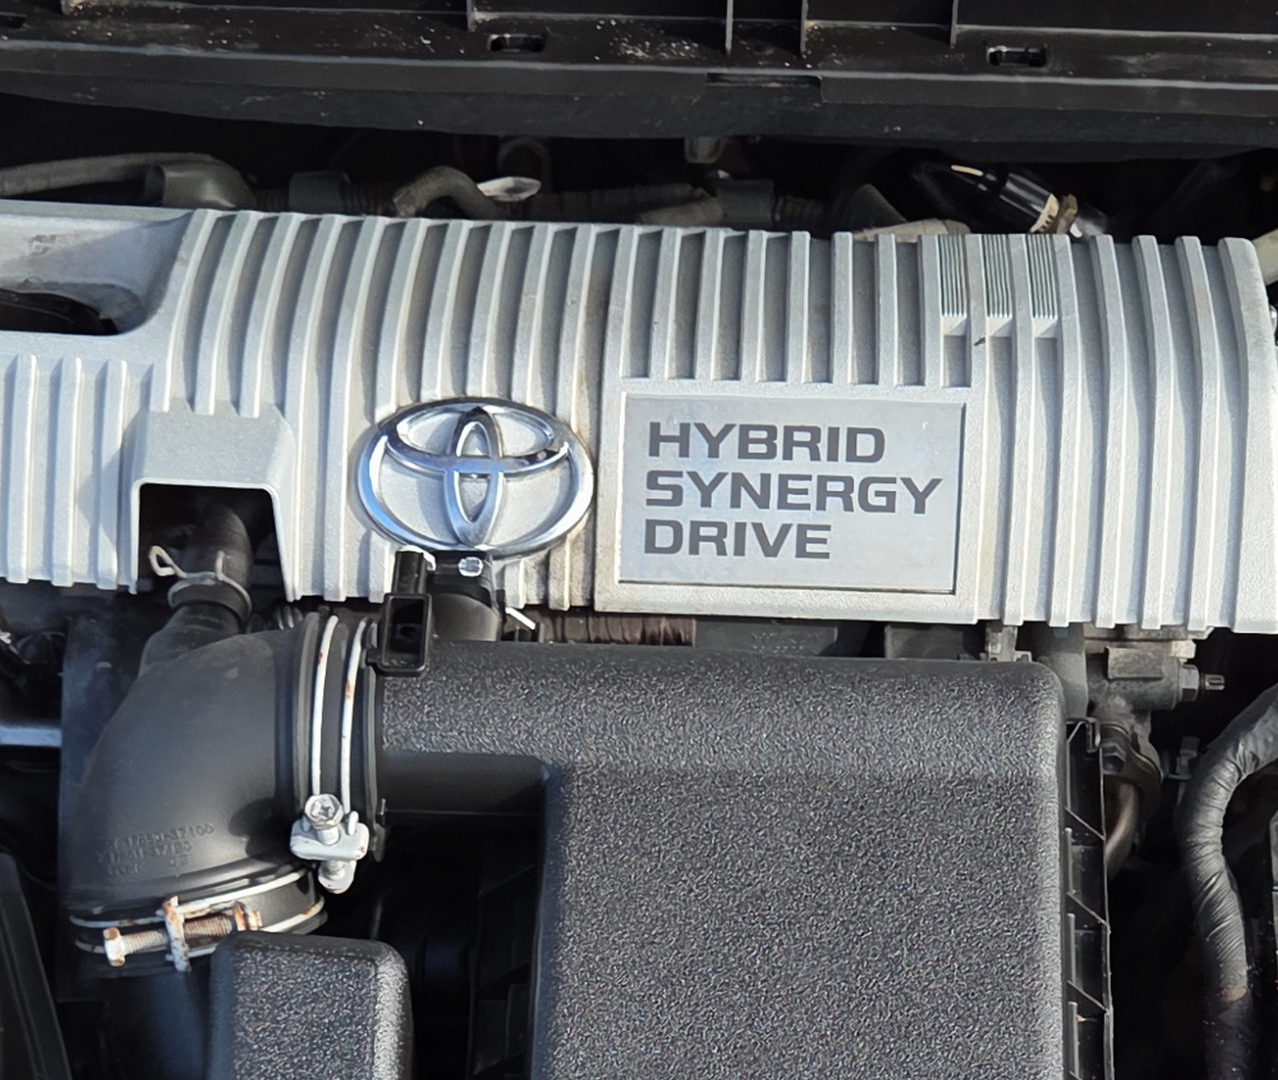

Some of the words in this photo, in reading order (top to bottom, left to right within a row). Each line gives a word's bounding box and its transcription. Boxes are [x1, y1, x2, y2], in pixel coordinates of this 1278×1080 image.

[648, 421, 886, 464] HYBRID
[646, 470, 943, 514] SYNERGY
[644, 519, 832, 559] DRIVE
